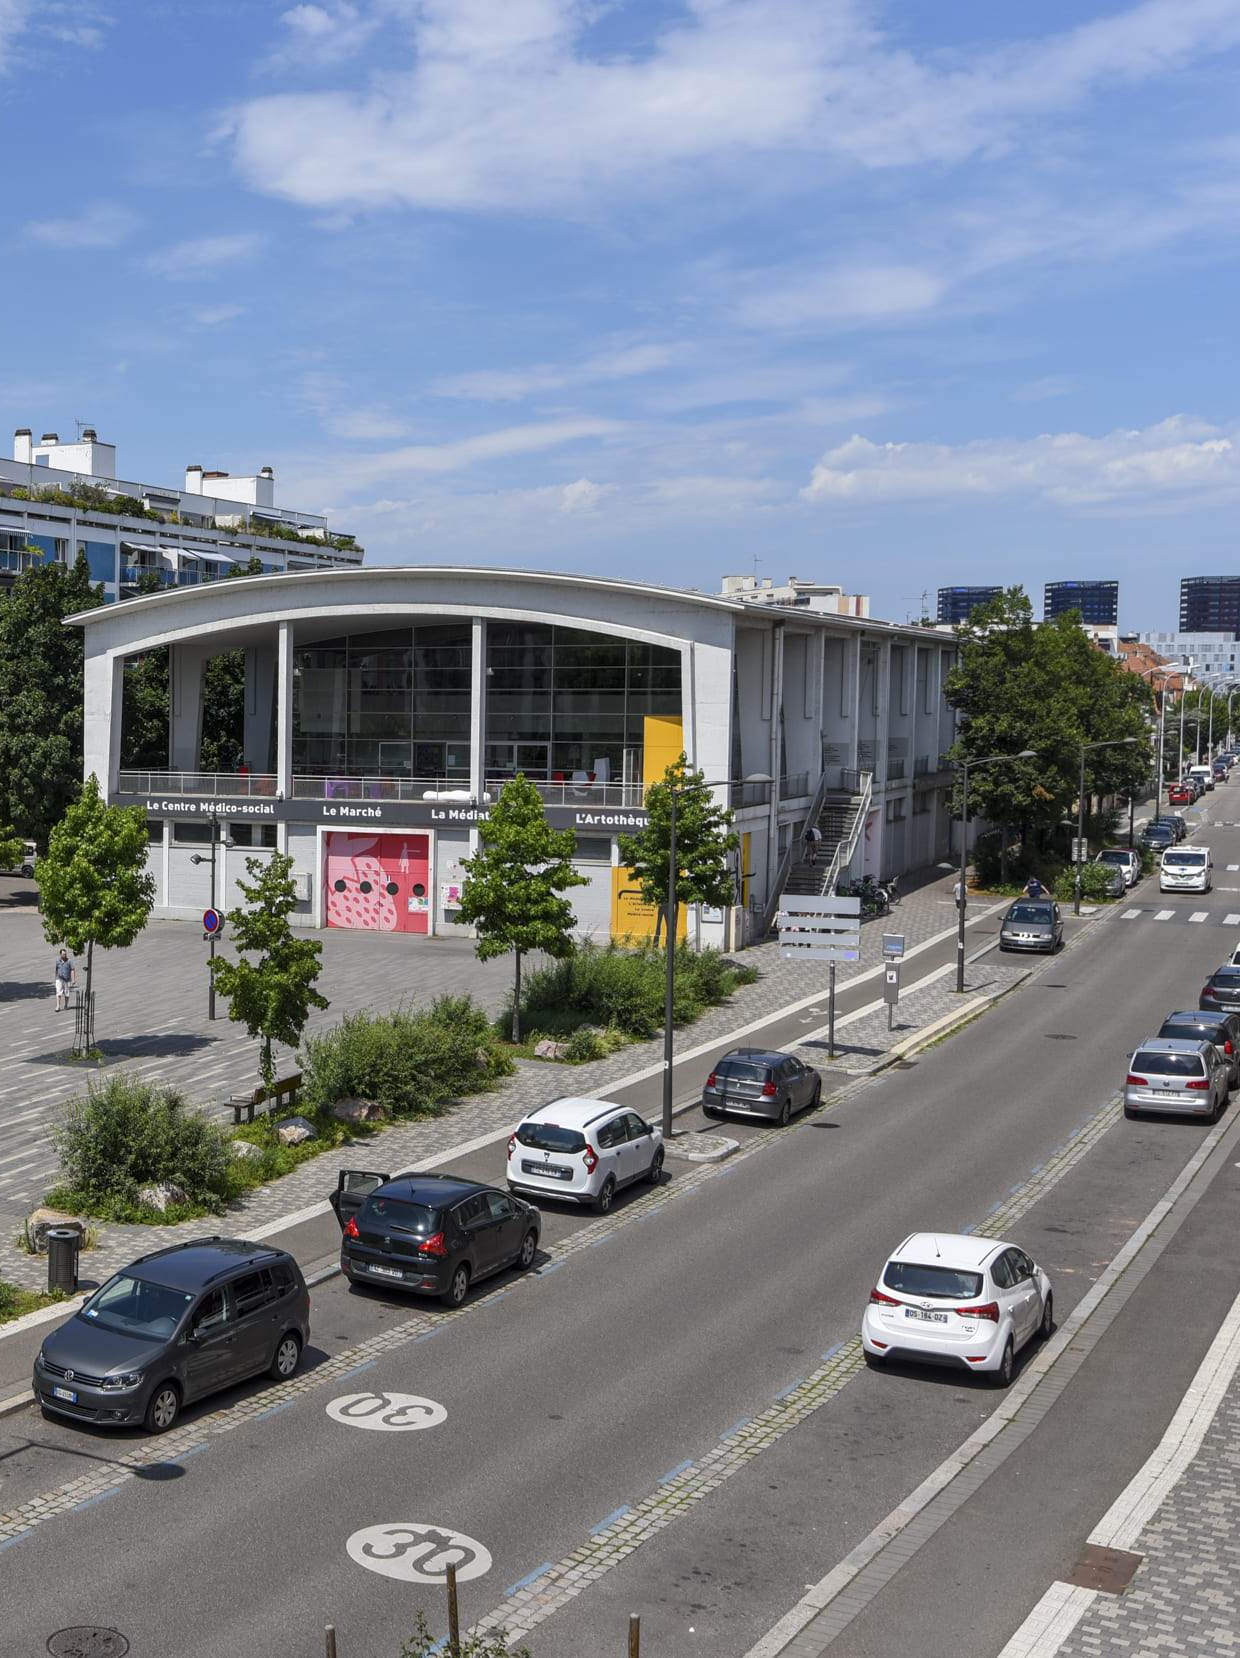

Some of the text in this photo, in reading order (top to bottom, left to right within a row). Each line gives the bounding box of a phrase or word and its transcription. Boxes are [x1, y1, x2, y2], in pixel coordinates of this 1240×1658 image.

[146, 800, 275, 814] Le Centre Médico-social
[322, 805, 383, 818] Le Marché
[431, 809, 491, 821] La Médiat
[575, 813, 650, 828] L'Artothèqu
[338, 1396, 435, 1427] 30
[361, 1528, 477, 1577] 30
